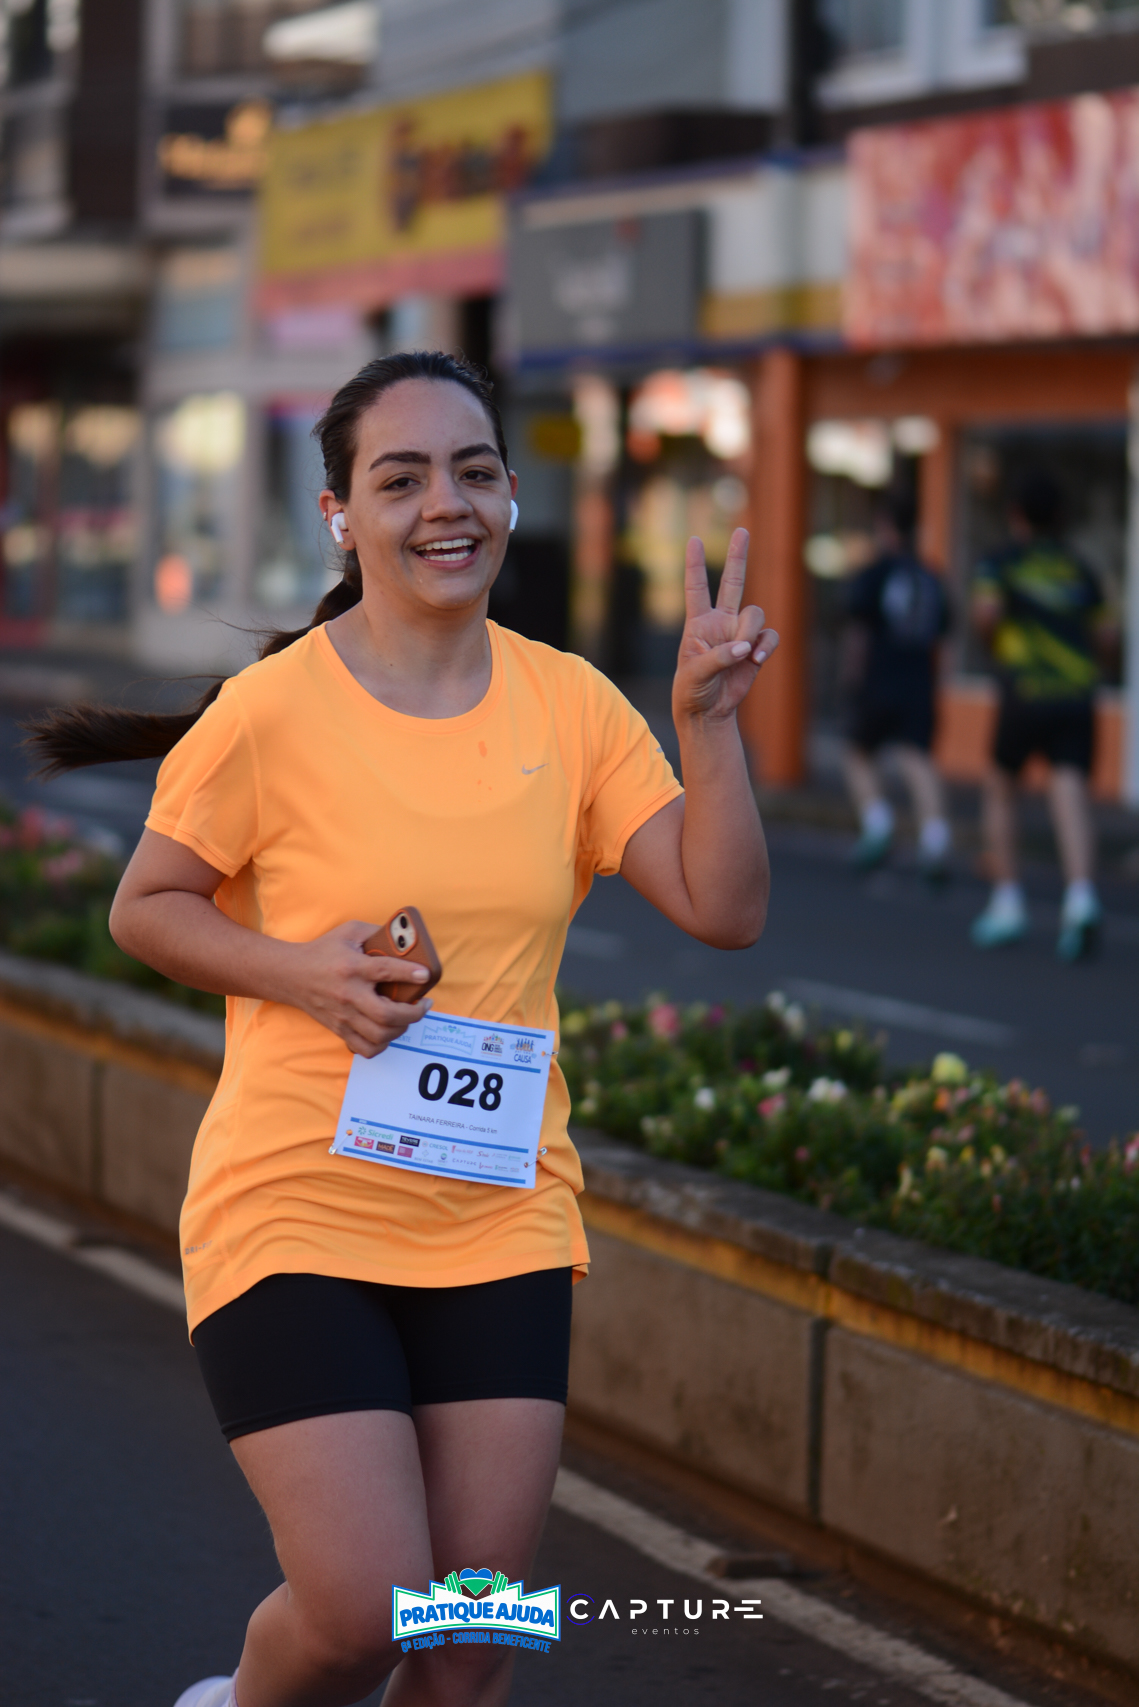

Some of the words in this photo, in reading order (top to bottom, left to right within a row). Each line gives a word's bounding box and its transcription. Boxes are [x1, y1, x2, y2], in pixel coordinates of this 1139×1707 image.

[418, 1063, 503, 1111] 028
[409, 1113, 434, 1124] TAINARA
[435, 1119, 465, 1129] FERREIRA
[469, 1125, 486, 1133] Corrida
[368, 1129, 394, 1140] Sicredi
[429, 1143, 448, 1151] CRESOL
